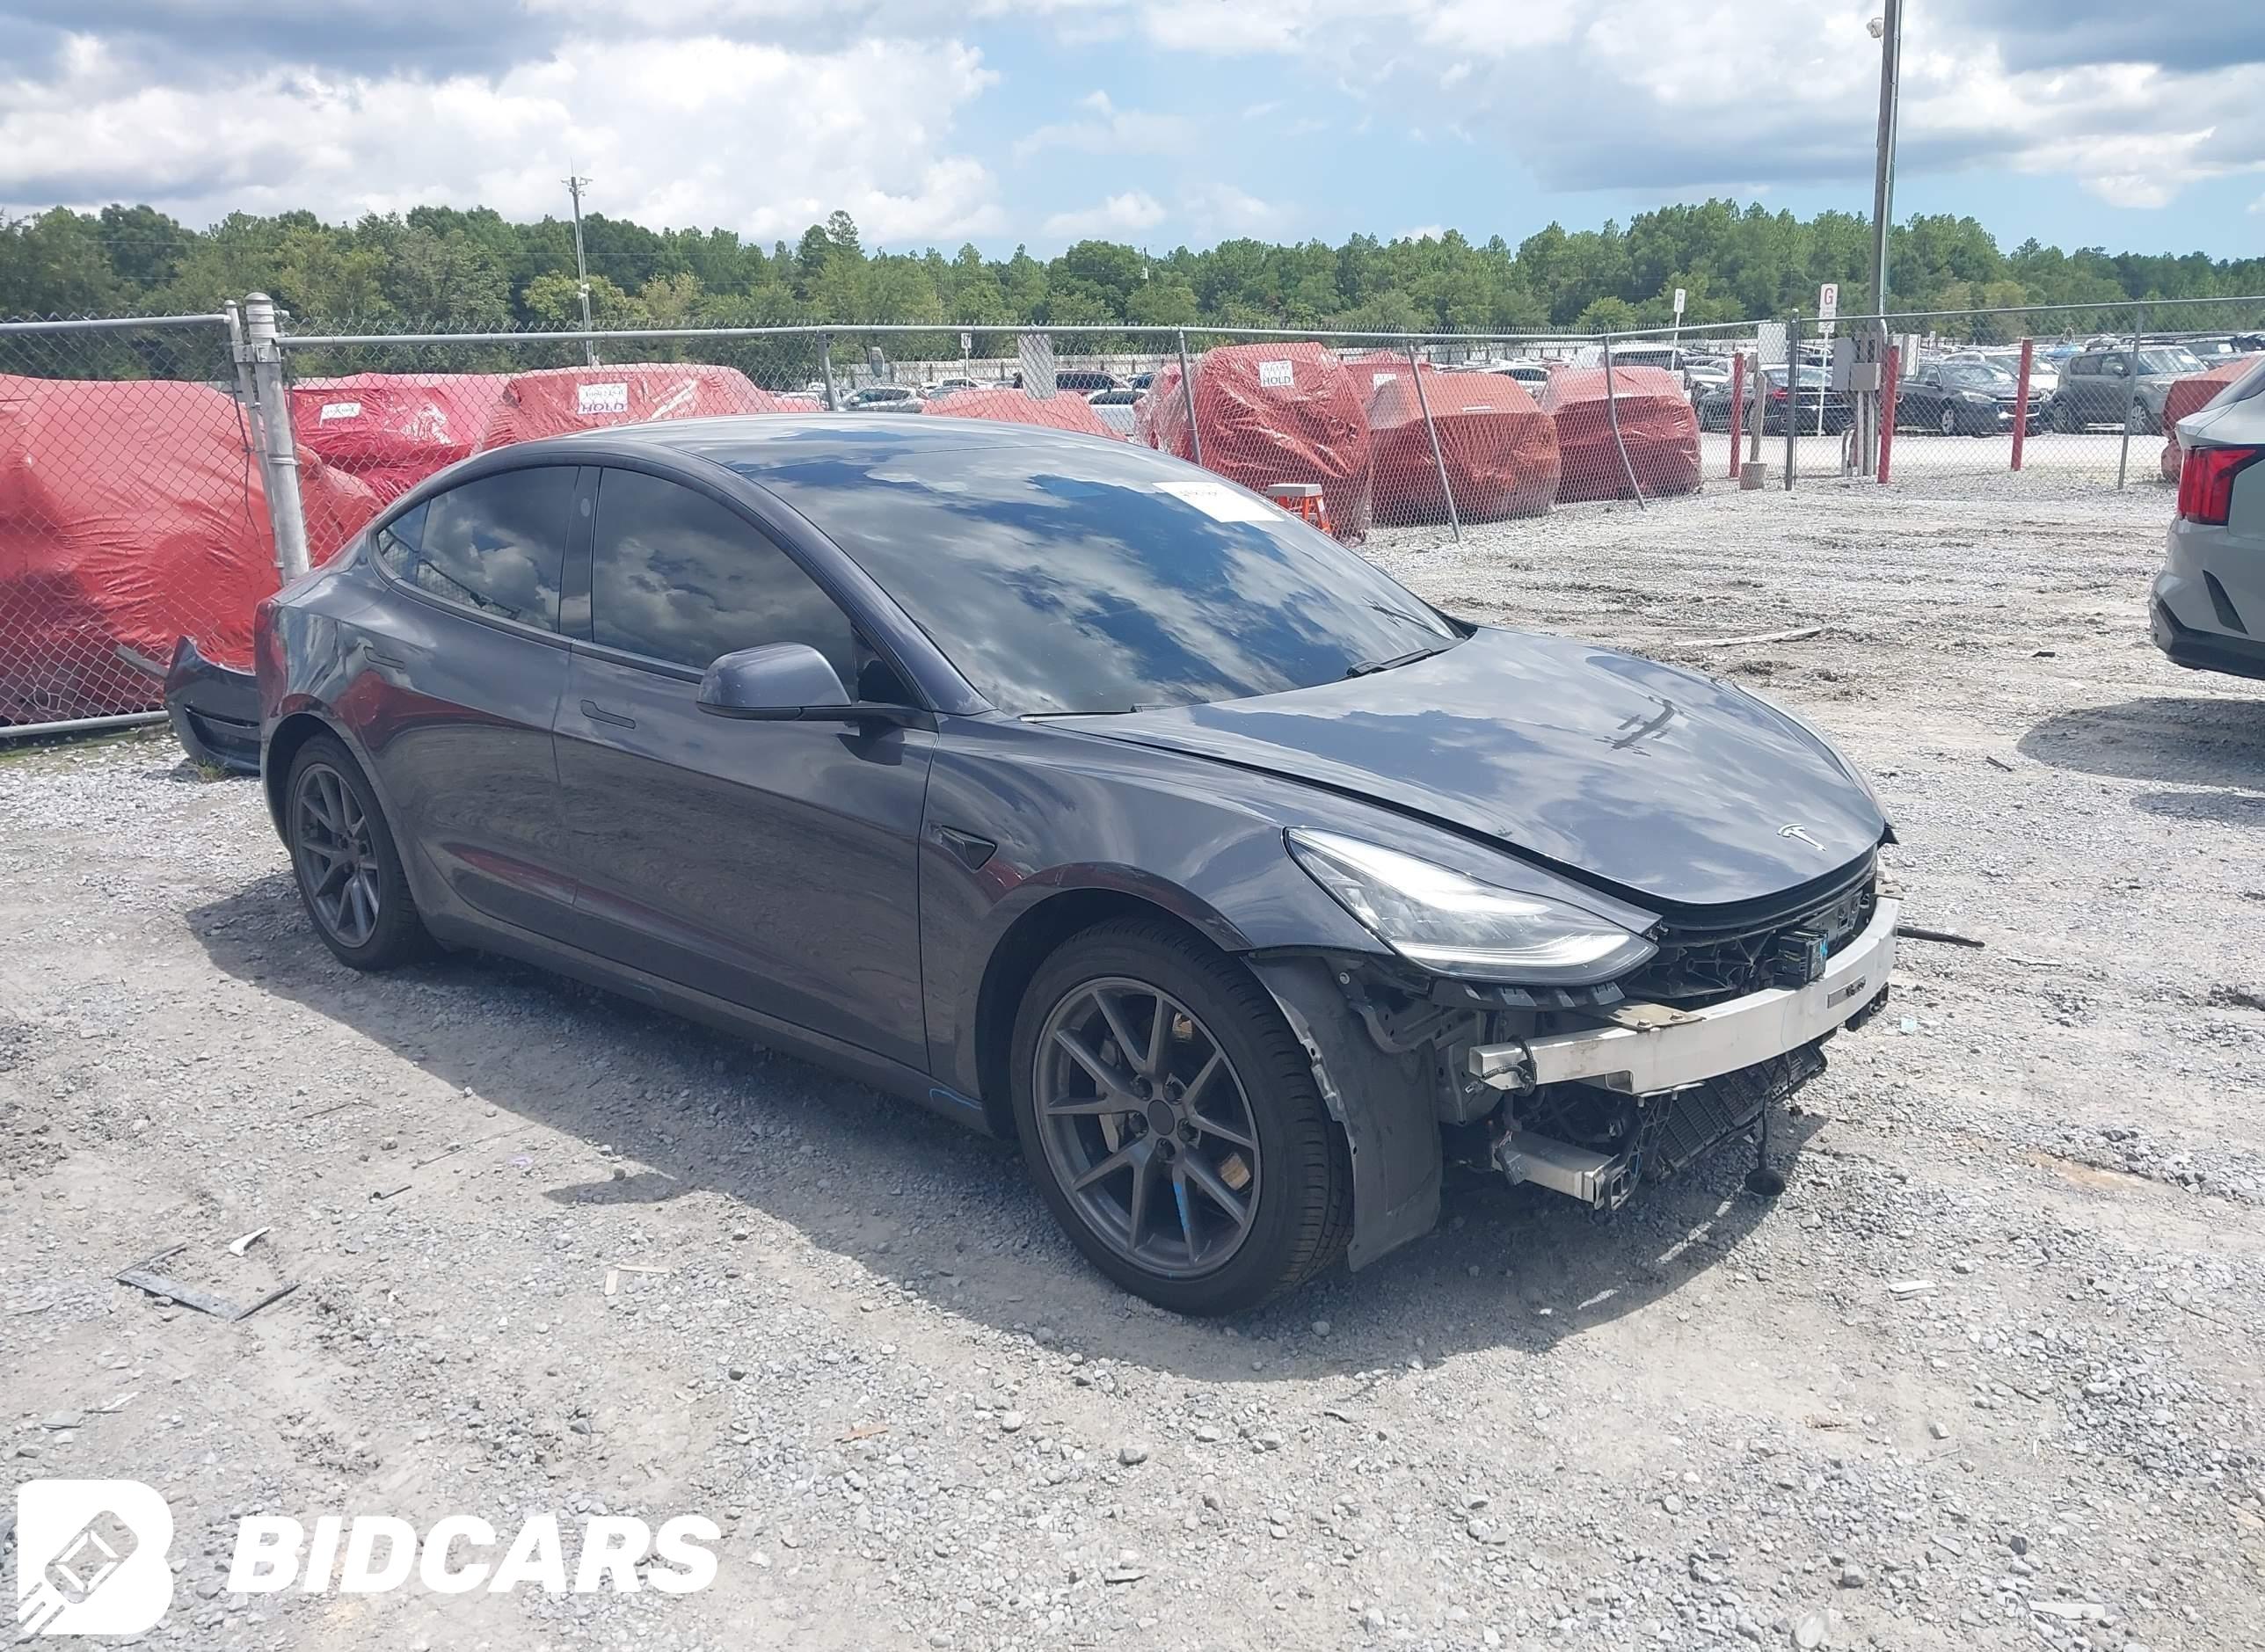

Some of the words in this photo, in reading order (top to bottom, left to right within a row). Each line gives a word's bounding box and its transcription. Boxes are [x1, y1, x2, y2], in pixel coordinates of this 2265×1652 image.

[1824, 287, 1834, 305] G
[1263, 375, 1291, 385] HOLD
[581, 403, 624, 411] HOLD
